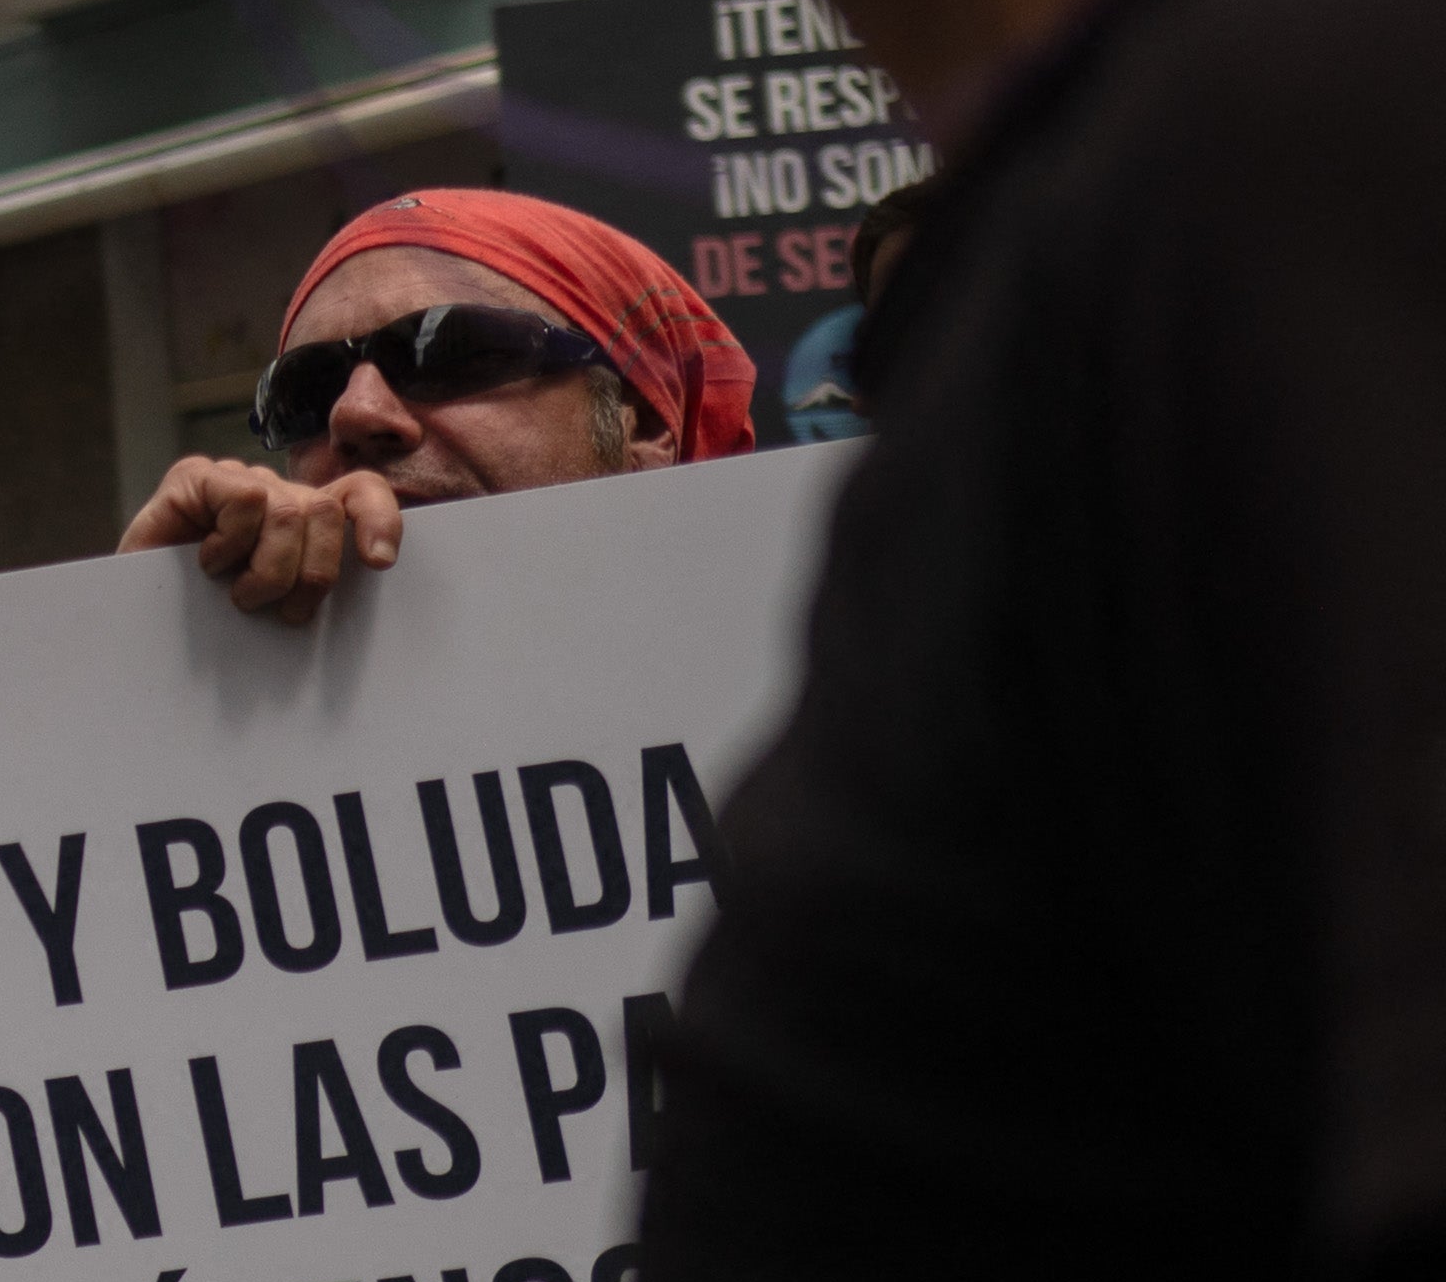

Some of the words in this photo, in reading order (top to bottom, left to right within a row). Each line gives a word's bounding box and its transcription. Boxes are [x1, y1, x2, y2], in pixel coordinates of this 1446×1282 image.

[681, 71, 759, 143] SE
[764, 63, 920, 136] RESP
[691, 230, 767, 301] DE
[774, 222, 863, 295] SE
[187, 1022, 484, 1228] LAS
